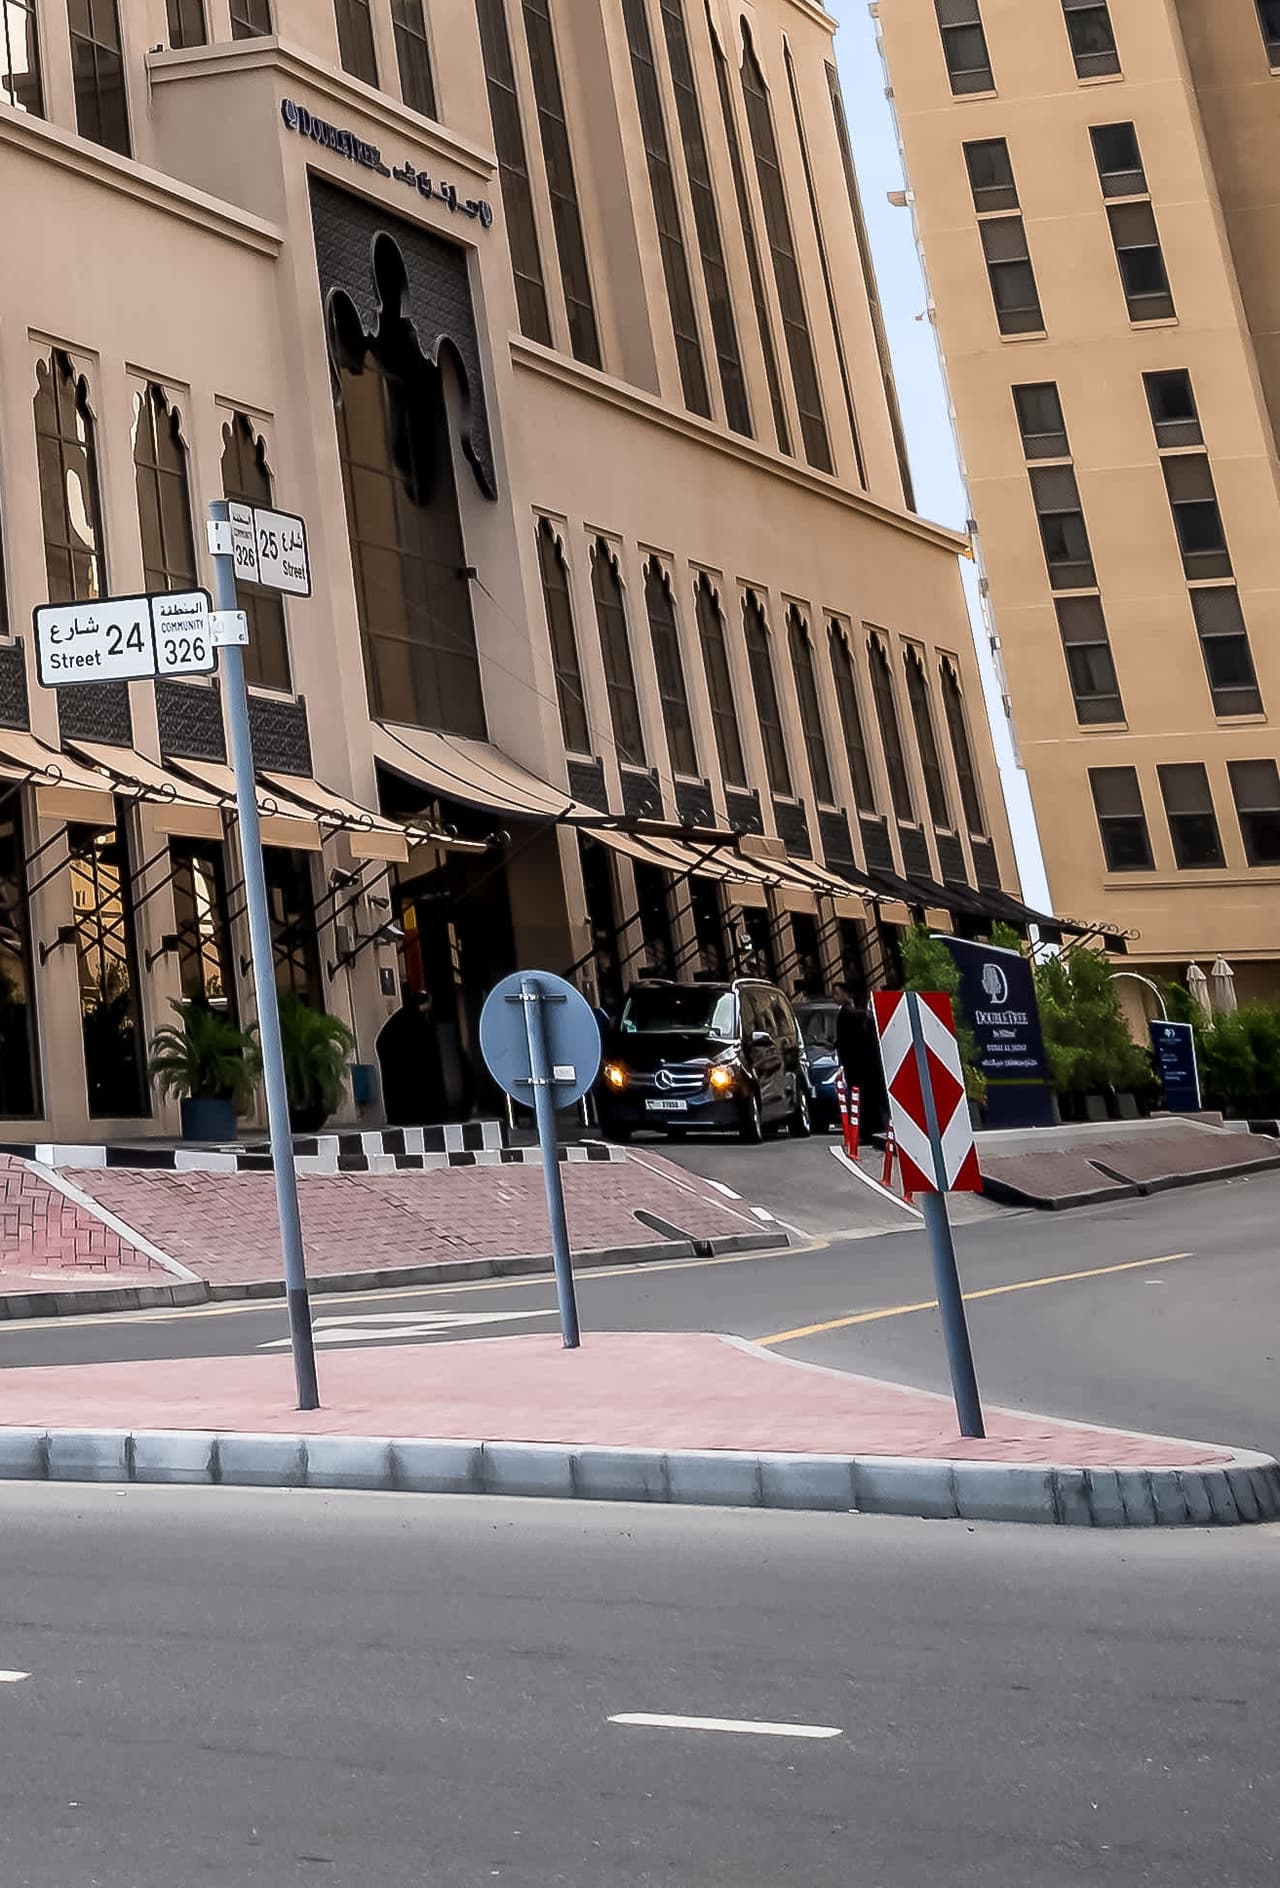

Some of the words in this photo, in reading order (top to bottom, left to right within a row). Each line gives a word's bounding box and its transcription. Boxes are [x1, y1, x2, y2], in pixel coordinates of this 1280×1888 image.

[235, 543, 255, 568] 326
[260, 529, 279, 560] 25
[282, 559, 306, 581] Street
[160, 601, 203, 617] المنطقة
[50, 617, 99, 644] شارع
[105, 622, 145, 656] 24
[161, 619, 204, 634] COMMUNITY
[50, 649, 102, 669] Street
[164, 637, 206, 666] 326
